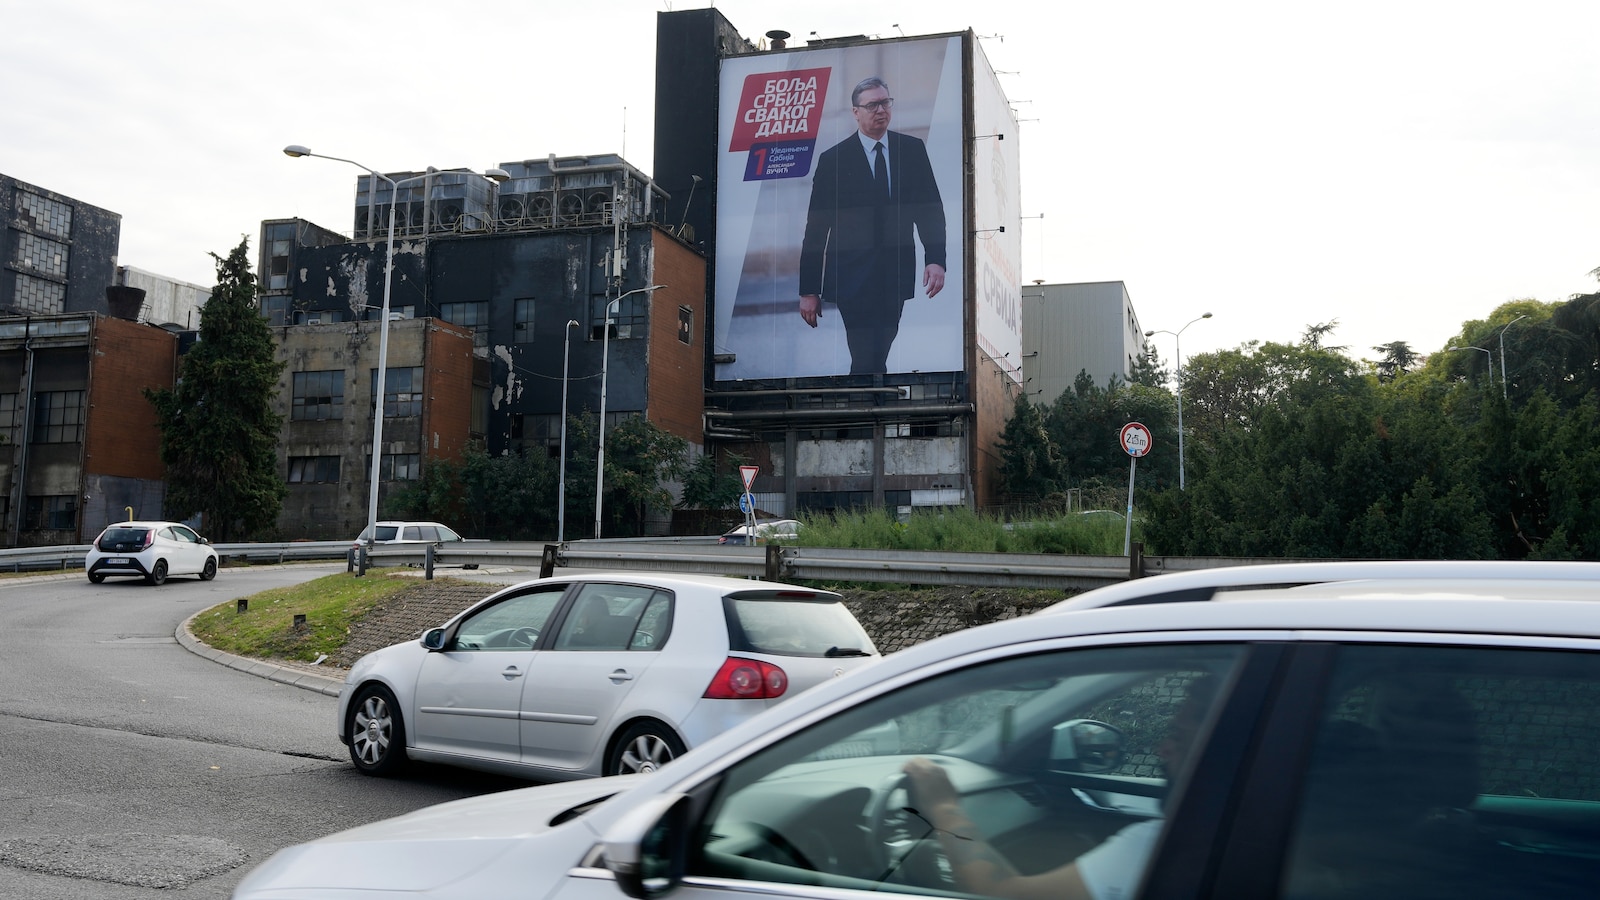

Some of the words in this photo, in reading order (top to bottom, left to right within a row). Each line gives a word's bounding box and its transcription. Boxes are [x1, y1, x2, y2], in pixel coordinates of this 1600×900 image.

[764, 76, 817, 94] БОЉА
[753, 90, 816, 108] СРБИЈА
[744, 104, 815, 123] СВАКОГ
[755, 119, 808, 138] ДАНА
[769, 153, 794, 162] Србија
[771, 146, 808, 154] Уједињена
[754, 148, 767, 176] 1
[983, 261, 1017, 336] СРБИЈА
